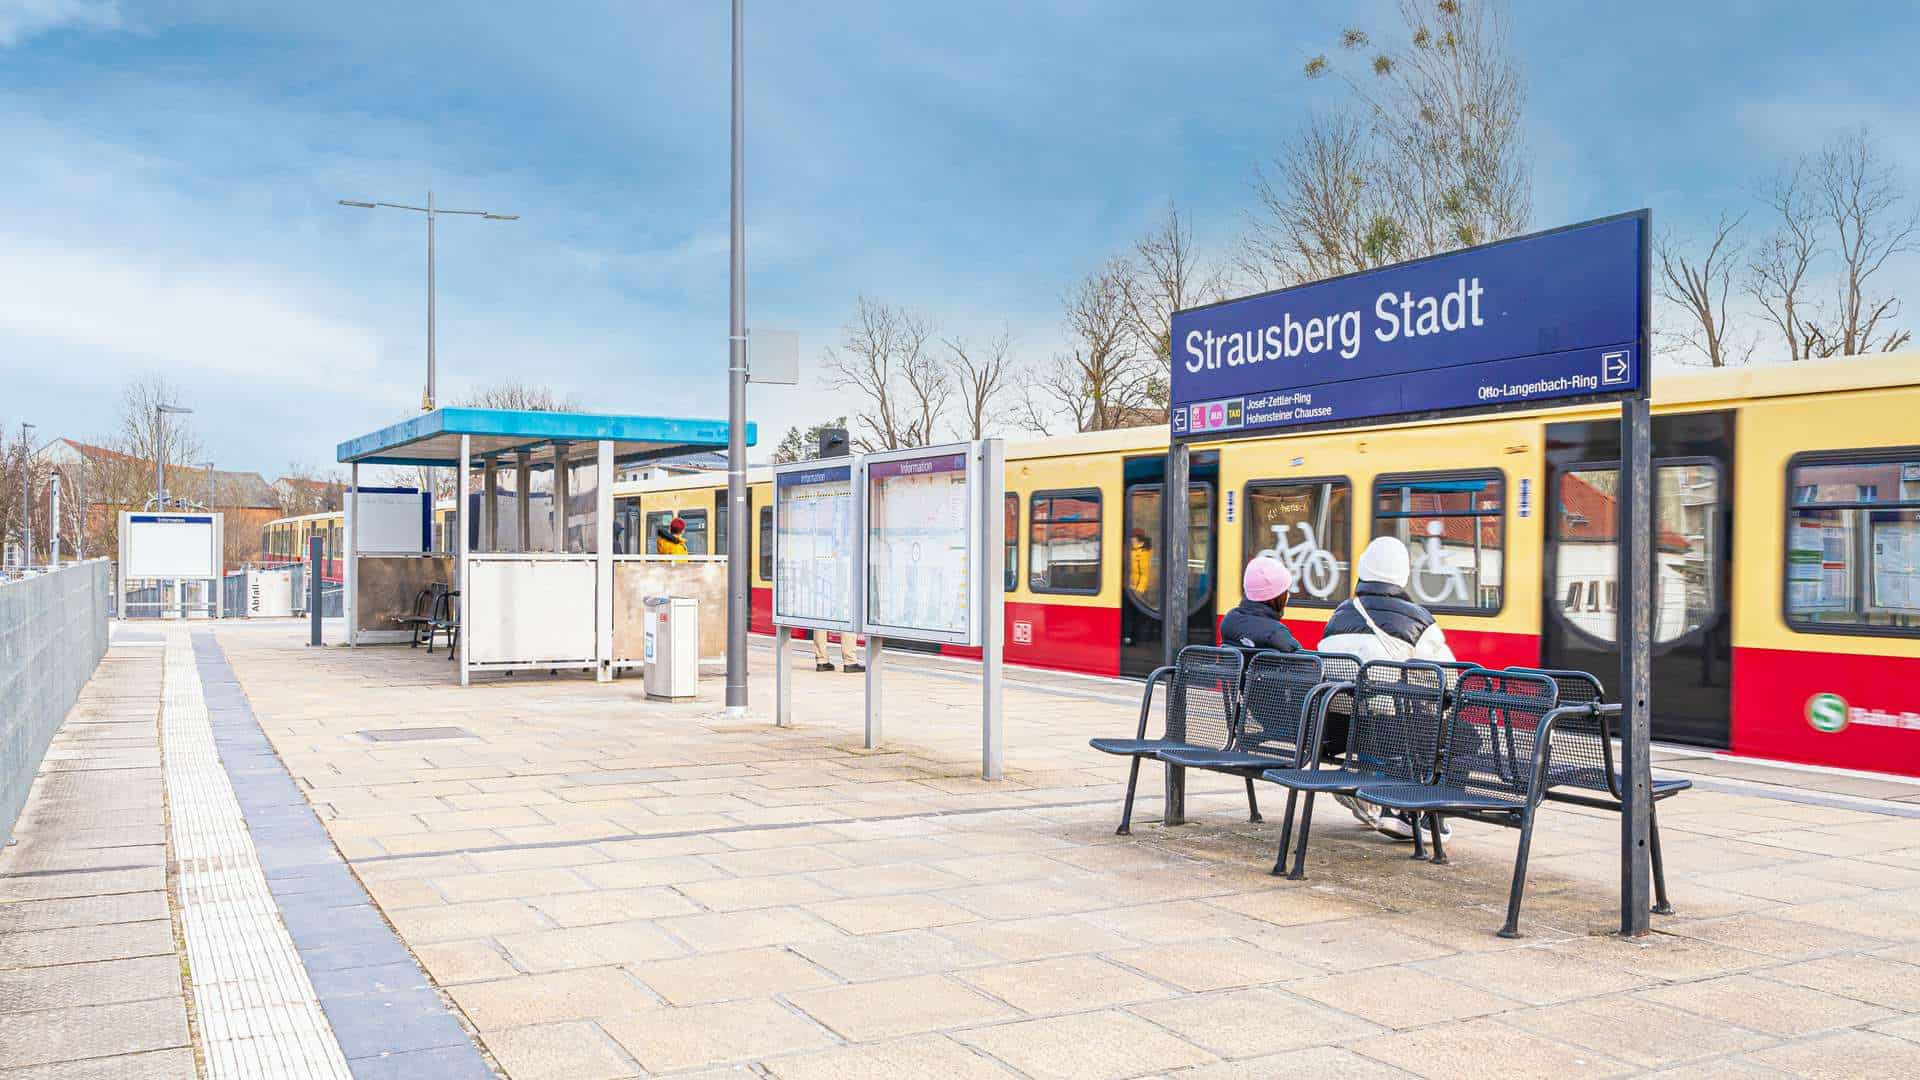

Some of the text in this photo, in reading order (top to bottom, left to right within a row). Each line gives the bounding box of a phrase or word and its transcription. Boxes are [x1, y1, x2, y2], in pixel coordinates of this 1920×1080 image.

[1185, 277, 1485, 373] Strausberg Stadt
[1478, 374, 1598, 399] Otto-Langenbach-Ring
[1228, 408, 1241, 418] TAXI
[1246, 406, 1332, 425] Hohensteiner Chaussee
[900, 461, 933, 474] Information
